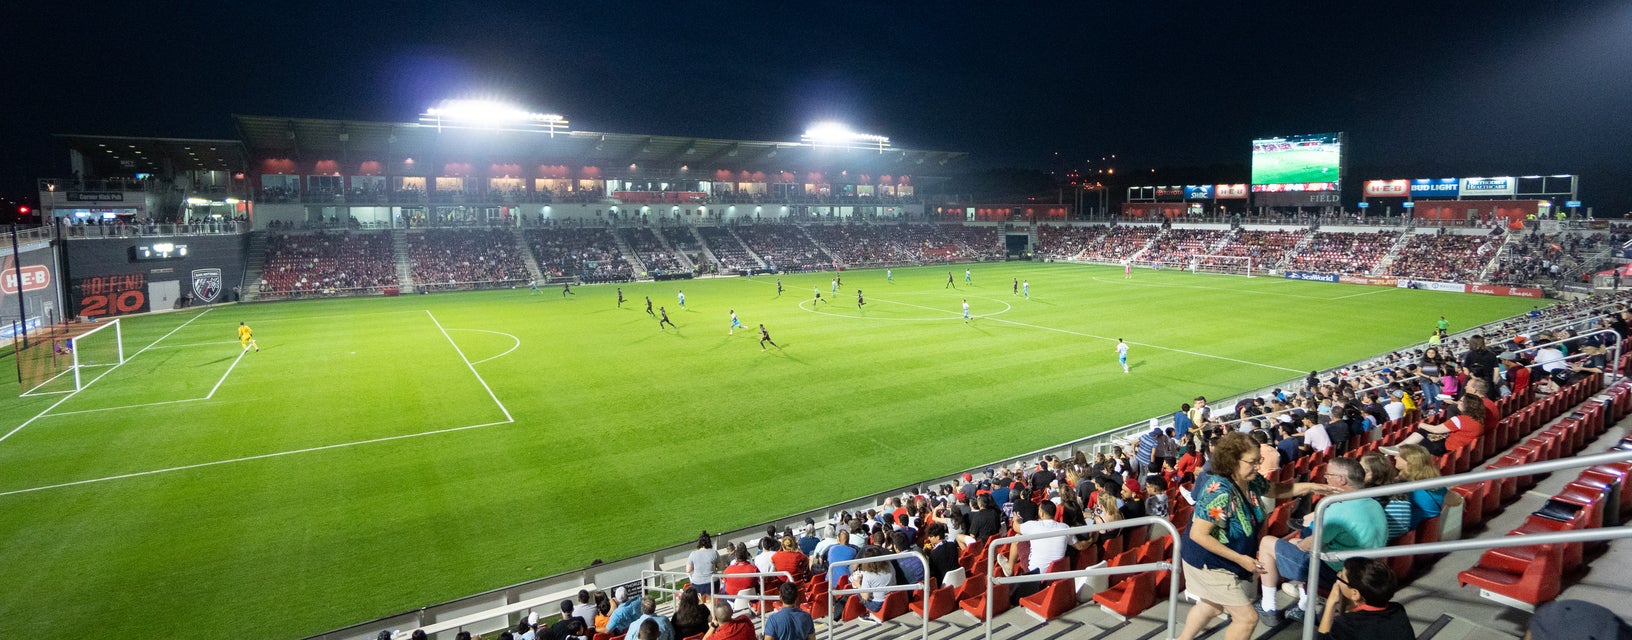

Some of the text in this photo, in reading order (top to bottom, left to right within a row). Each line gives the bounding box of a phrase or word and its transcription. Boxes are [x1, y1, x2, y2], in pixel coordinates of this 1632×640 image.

[1430, 183, 1458, 191] LIGHT
[1310, 194, 1340, 203] FIELD
[1301, 273, 1334, 282] SeaWorld
[82, 273, 144, 296] #DEFEND
[80, 290, 144, 317] 210
